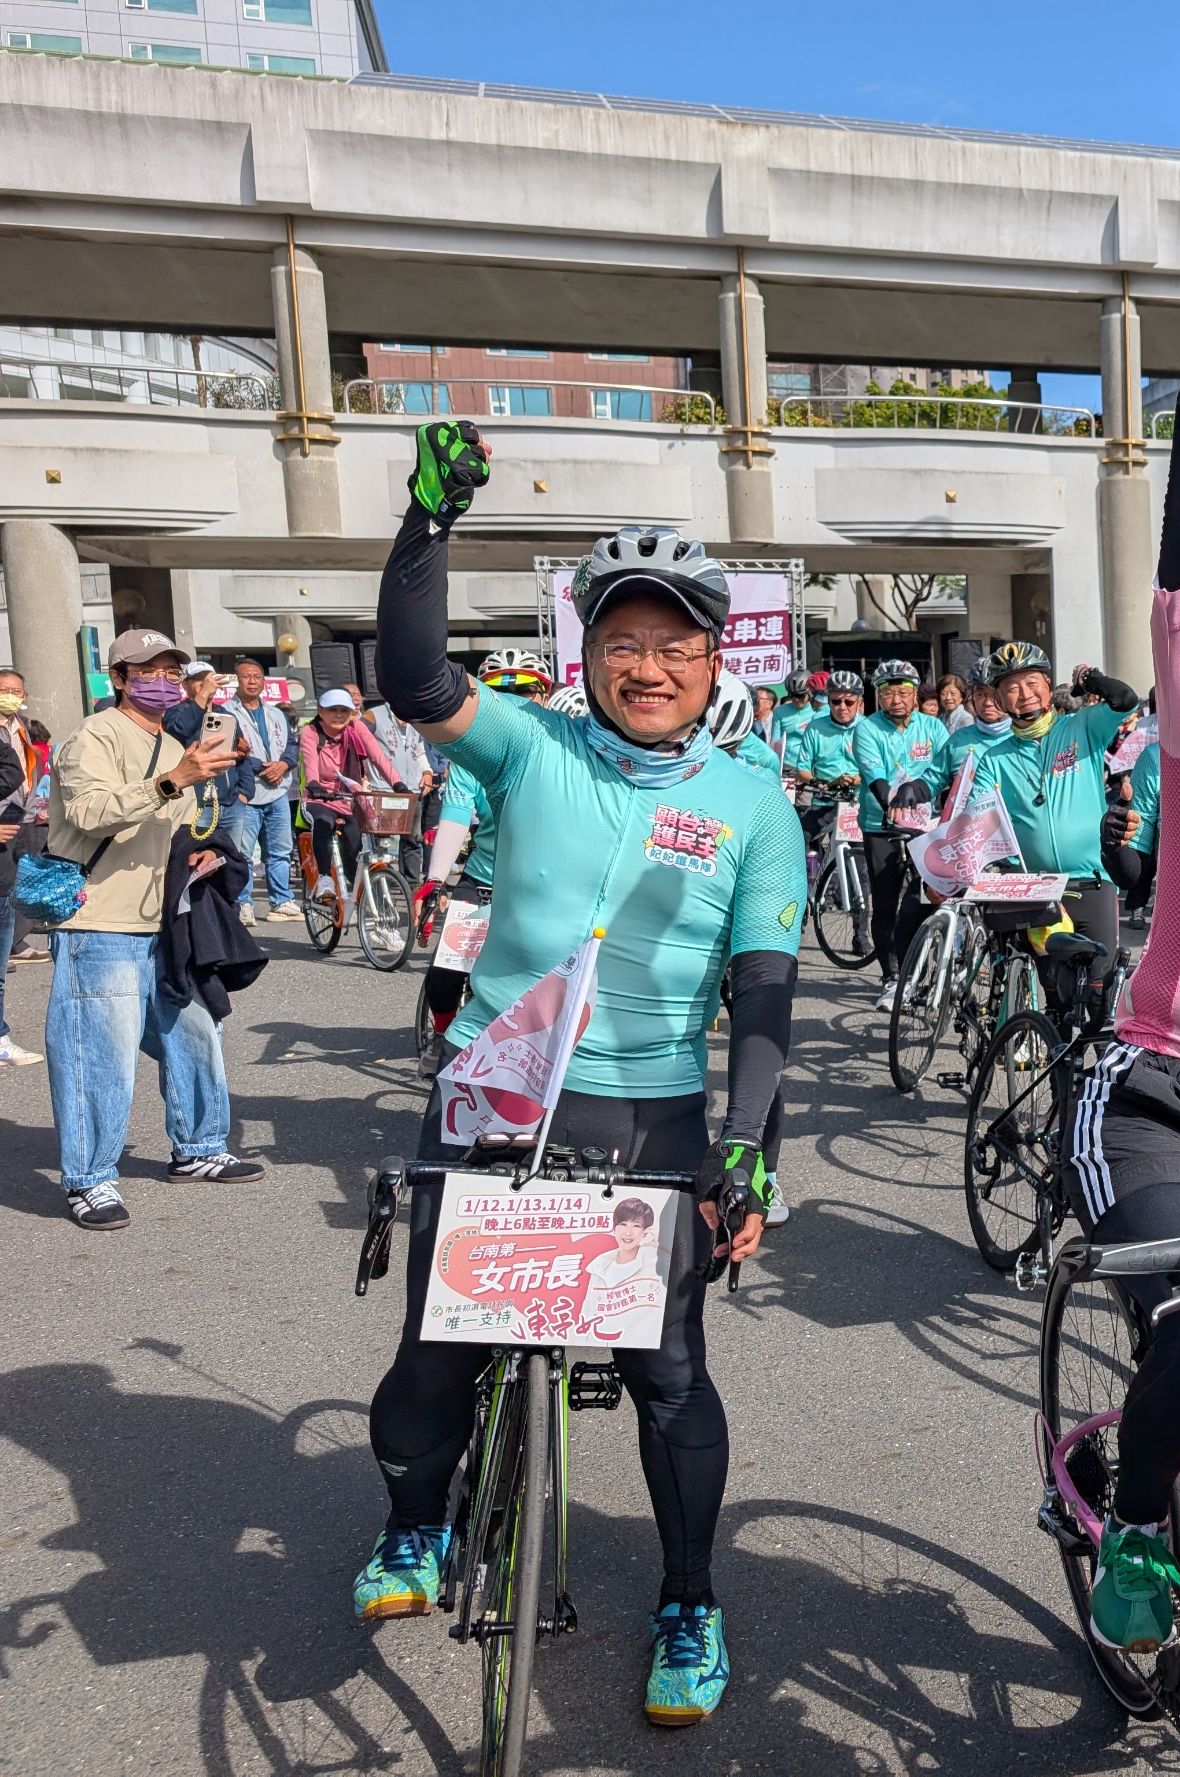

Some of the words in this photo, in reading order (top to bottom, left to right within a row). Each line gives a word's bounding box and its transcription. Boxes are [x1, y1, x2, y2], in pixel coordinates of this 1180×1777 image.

[651, 823, 717, 859] 護民主
[464, 1198, 582, 1212] 1/12.1/13.1/14
[484, 1216, 610, 1232] 晚上6點至晚上10點
[471, 1254, 583, 1294] 女市長
[444, 1310, 511, 1330] 唯一支持
